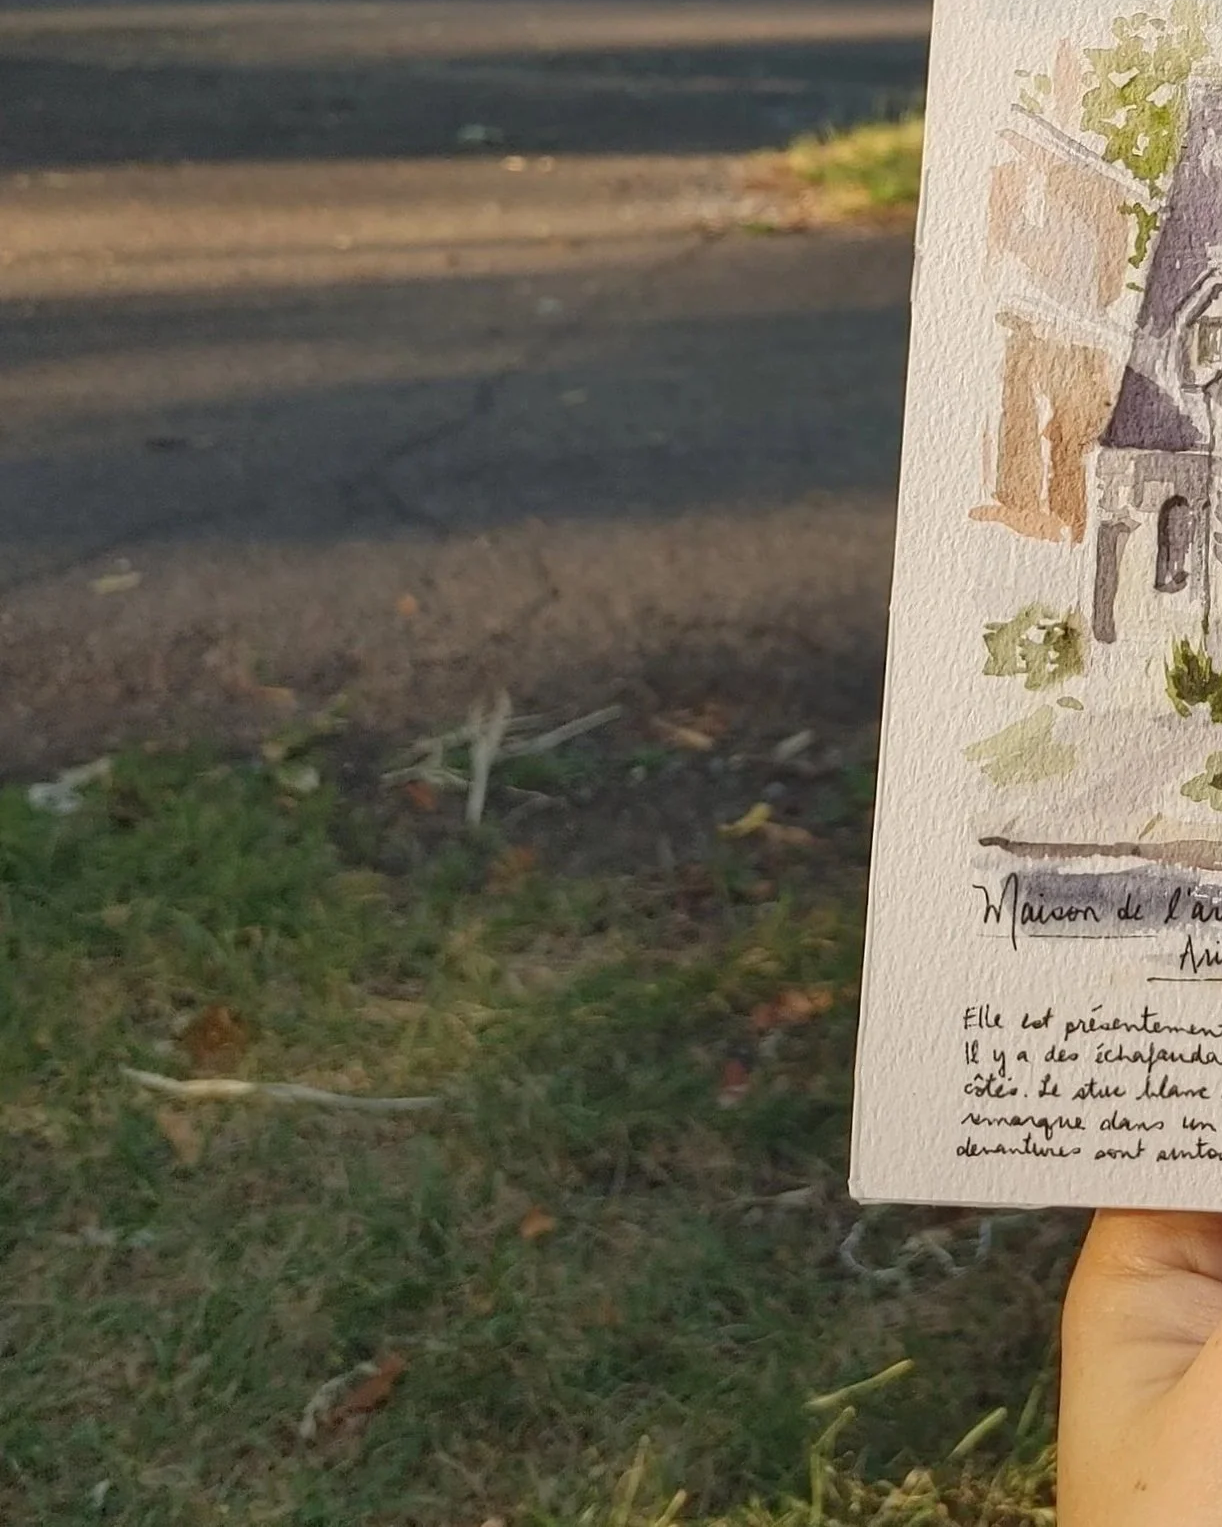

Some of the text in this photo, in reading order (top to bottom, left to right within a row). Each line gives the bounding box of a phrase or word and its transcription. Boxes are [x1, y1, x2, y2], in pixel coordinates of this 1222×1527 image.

[973, 872, 1100, 950] Maison
[1117, 895, 1144, 921] de
[963, 1004, 1003, 1029] Elle
[1022, 1007, 1054, 1029] est
[965, 1041, 979, 1065] Il
[993, 1047, 1006, 1077] y
[1017, 1050, 1029, 1063] a
[1044, 1044, 1079, 1063] des
[964, 1072, 1029, 1099] côtés.
[1038, 1074, 1061, 1098] Le
[1072, 1077, 1126, 1101] stuc
[1135, 1075, 1211, 1101] blanc
[961, 1112, 1086, 1140] remarque
[1099, 1110, 1165, 1131] dans
[1182, 1116, 1217, 1132] un
[956, 1132, 1082, 1157] devantures
[1094, 1138, 1145, 1161] sont
